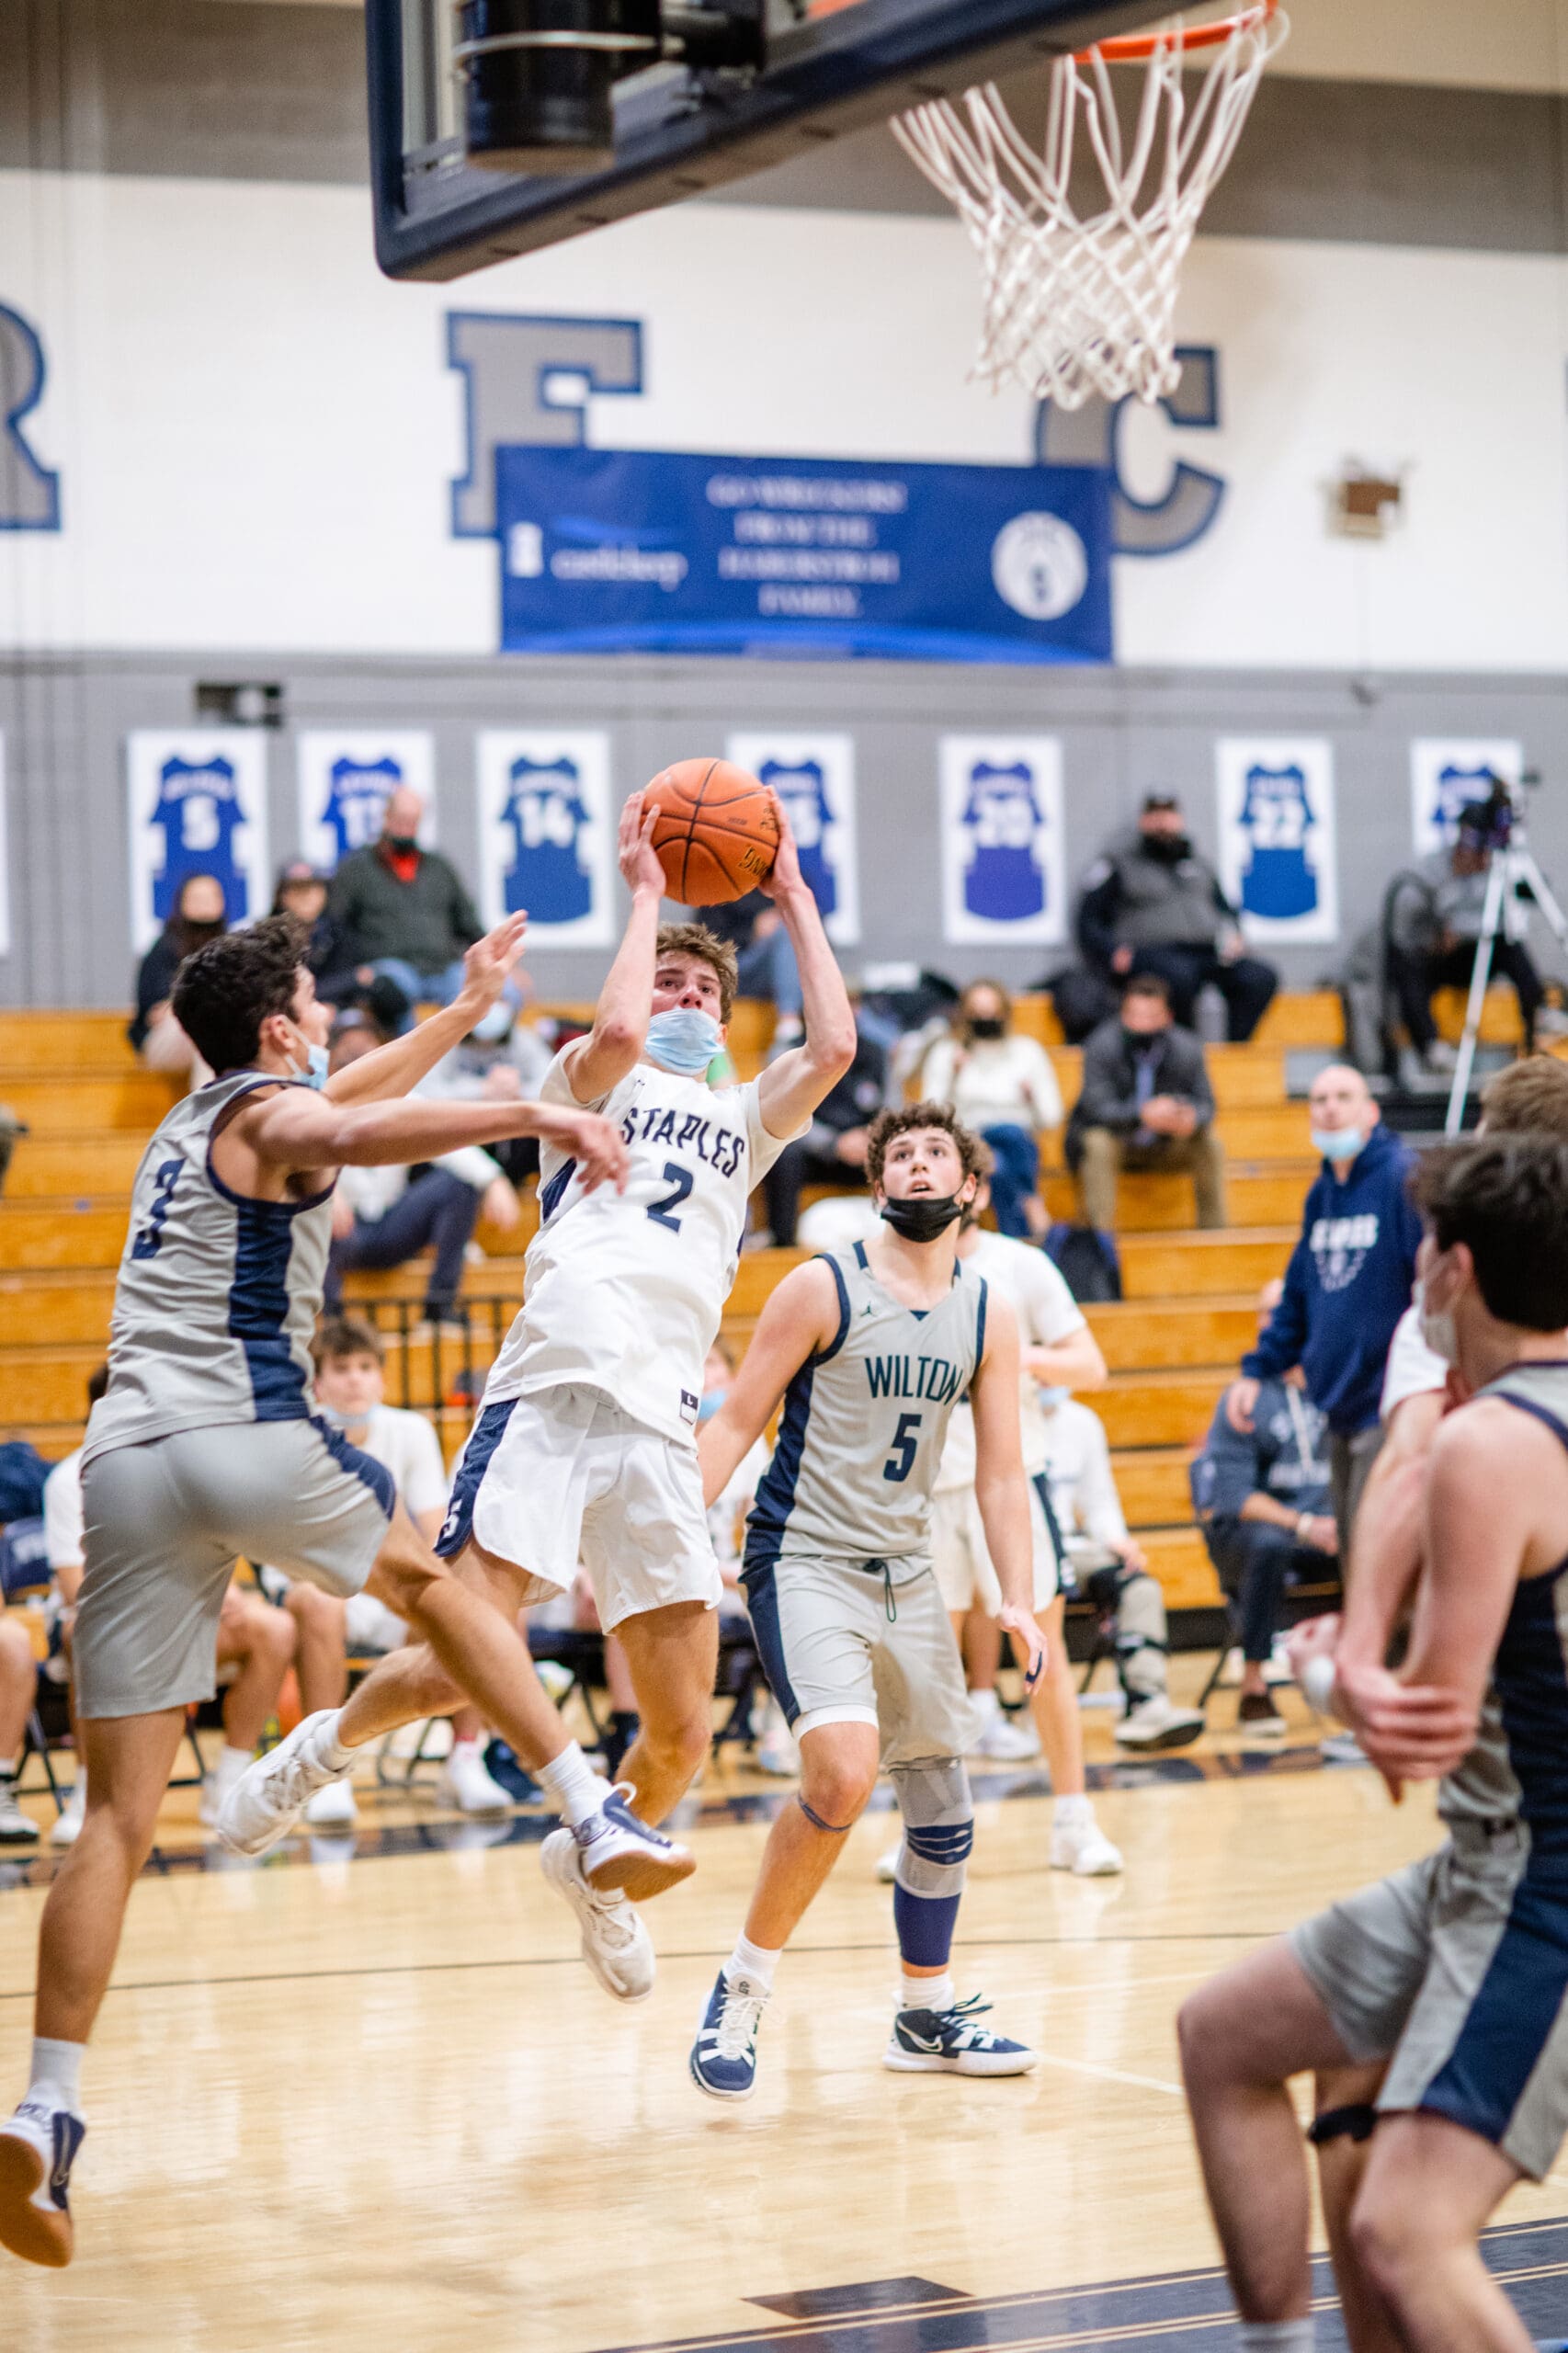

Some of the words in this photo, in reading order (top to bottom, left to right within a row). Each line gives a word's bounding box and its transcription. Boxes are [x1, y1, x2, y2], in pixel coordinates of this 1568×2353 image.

[619, 1107, 745, 1179] STAPLES
[647, 1161, 694, 1233] 2
[864, 1355, 963, 1406] WILTON
[883, 1413, 923, 1483] 5
